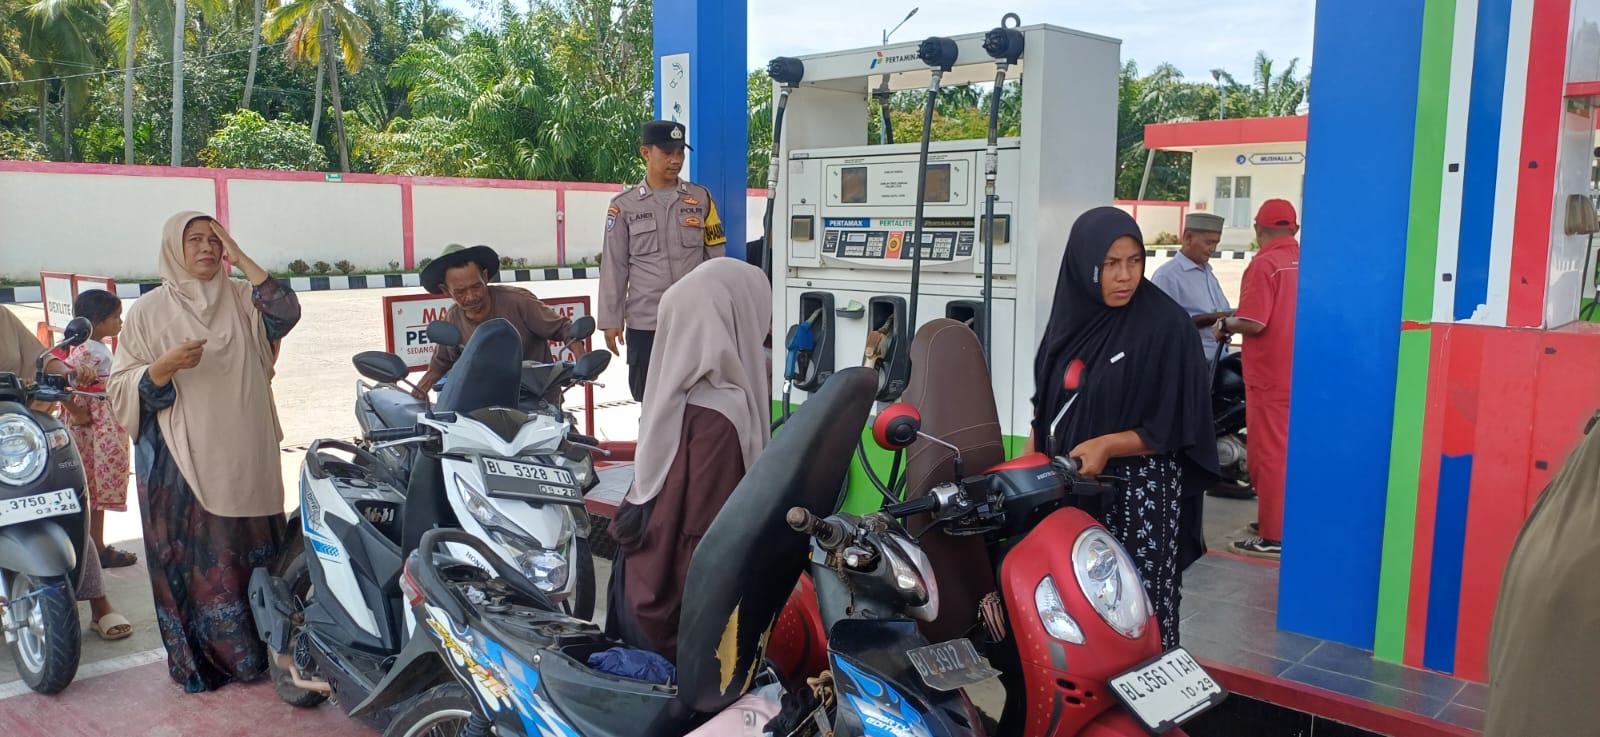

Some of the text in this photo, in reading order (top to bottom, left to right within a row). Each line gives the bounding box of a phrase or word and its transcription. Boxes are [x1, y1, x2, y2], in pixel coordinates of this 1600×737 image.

[829, 219, 863, 228] PERTAMAX
[879, 219, 914, 227] PERTALITE
[487, 460, 572, 484] BL 5328 TU
[9, 491, 72, 510] 3750 TV
[911, 651, 939, 677] BL
[930, 643, 966, 673] 3912
[1119, 653, 1199, 701] BL 3561 TAH
